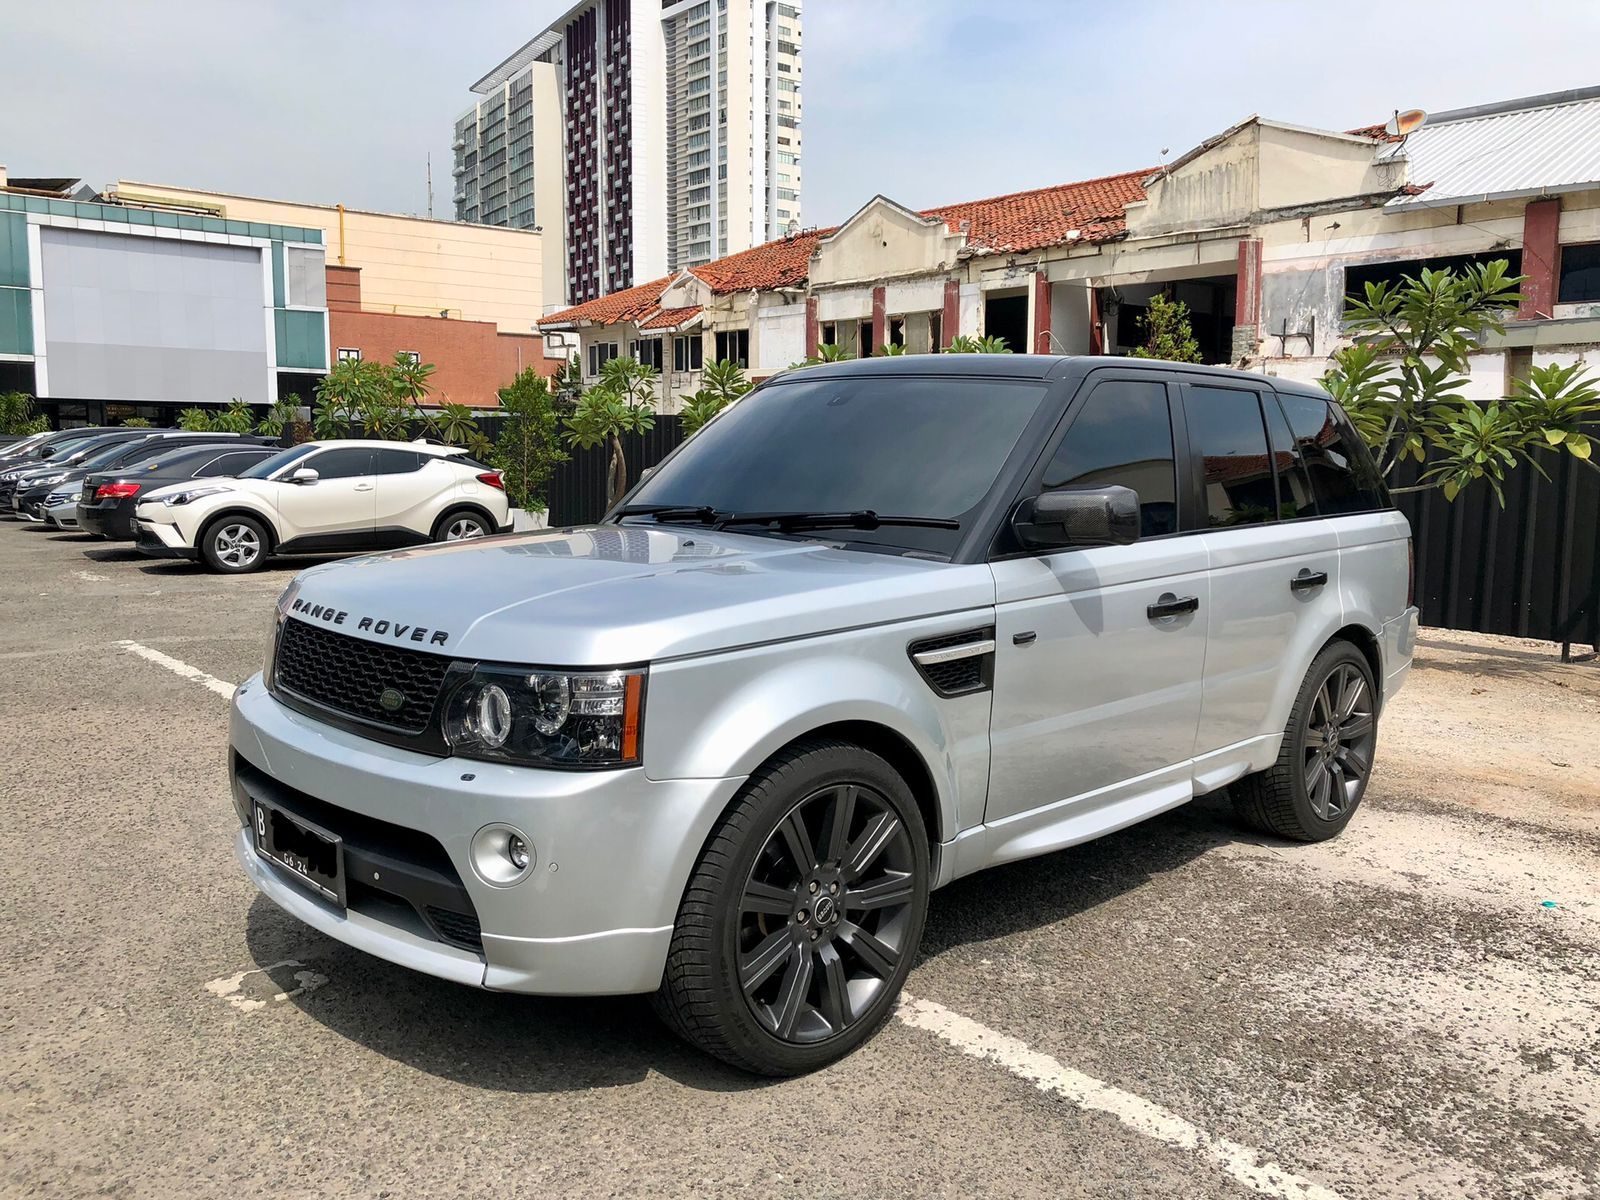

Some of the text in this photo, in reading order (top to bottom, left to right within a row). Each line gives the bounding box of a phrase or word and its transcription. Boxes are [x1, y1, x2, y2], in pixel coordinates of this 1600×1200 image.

[292, 598, 449, 646] RANGE ROVER
[256, 806, 266, 836] B
